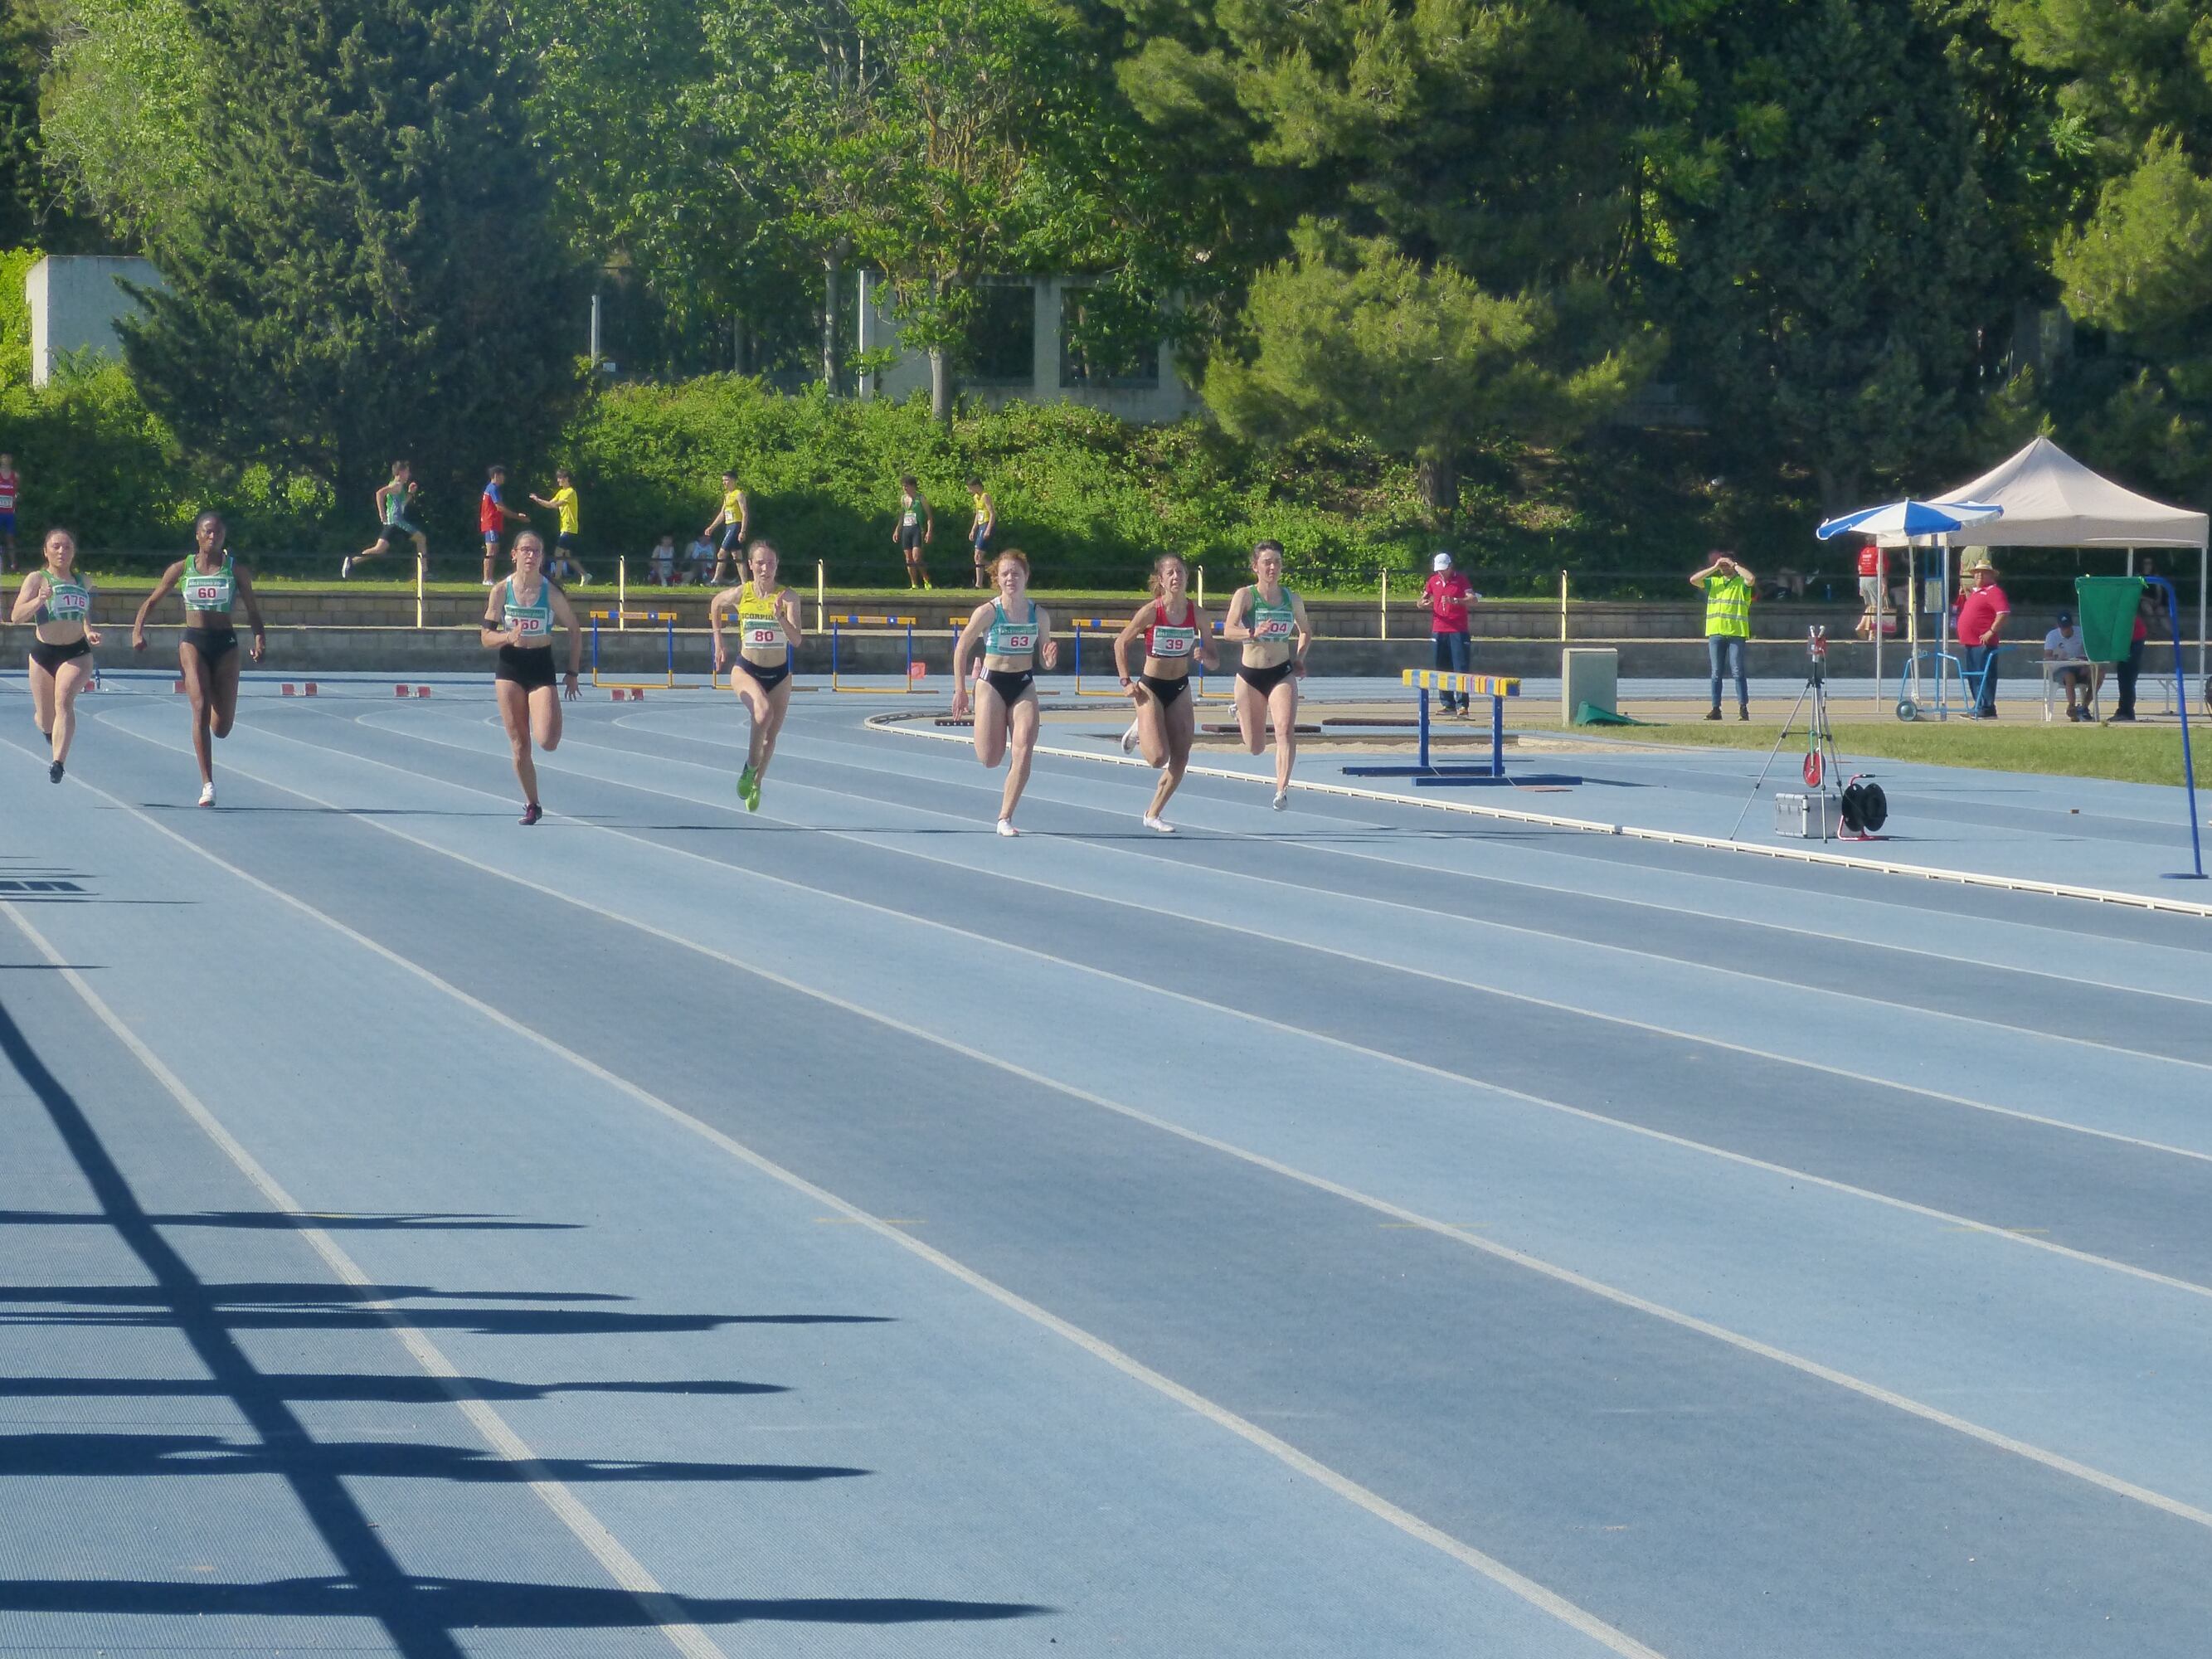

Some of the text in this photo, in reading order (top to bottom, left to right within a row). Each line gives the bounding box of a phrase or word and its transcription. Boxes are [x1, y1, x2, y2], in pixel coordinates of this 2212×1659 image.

[198, 587, 216, 598] 60
[63, 595, 85, 607] 176
[1271, 622, 1287, 633] 04
[755, 630, 774, 642] 80
[1010, 636, 1028, 646] 63
[1165, 639, 1184, 649] 39
